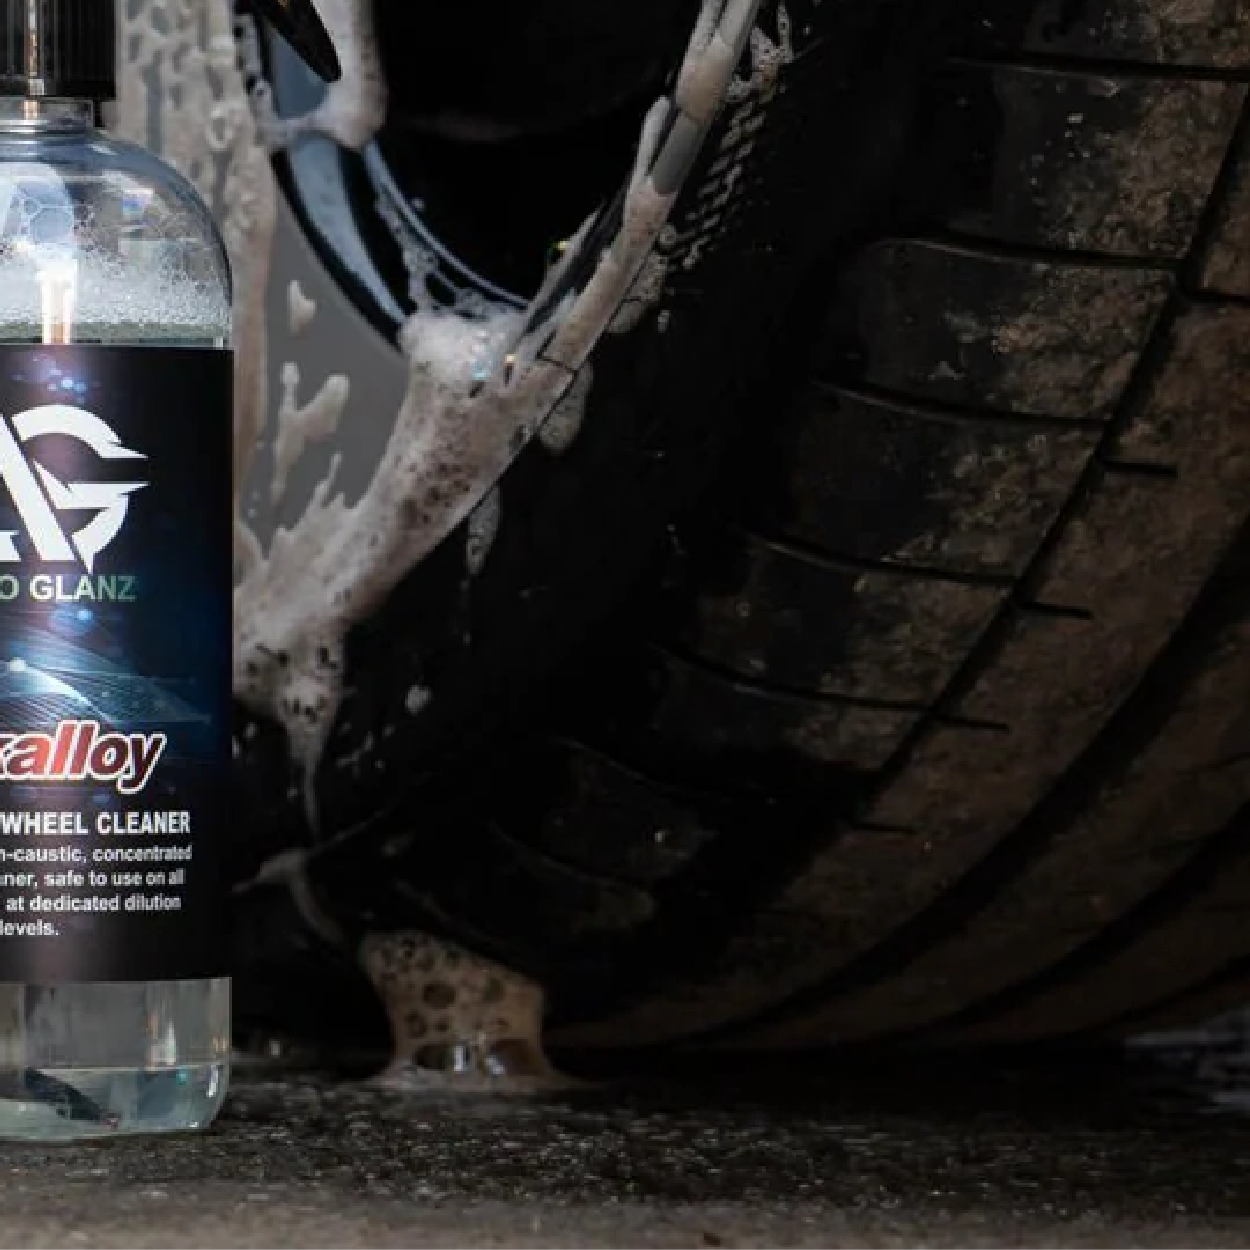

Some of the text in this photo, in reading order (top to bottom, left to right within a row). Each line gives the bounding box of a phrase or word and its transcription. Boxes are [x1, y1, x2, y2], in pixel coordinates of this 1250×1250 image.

[29, 575, 137, 600] GLANZ
[0, 810, 89, 835] WHEEL
[96, 810, 191, 835] CLEANER
[92, 844, 192, 862] concentrated
[44, 868, 85, 887] safe
[88, 869, 107, 887] to
[110, 871, 142, 886] use
[145, 871, 165, 886] on
[168, 867, 185, 886] all
[6, 894, 24, 912] at
[29, 893, 120, 912] dedicated
[124, 893, 182, 911] dilution
